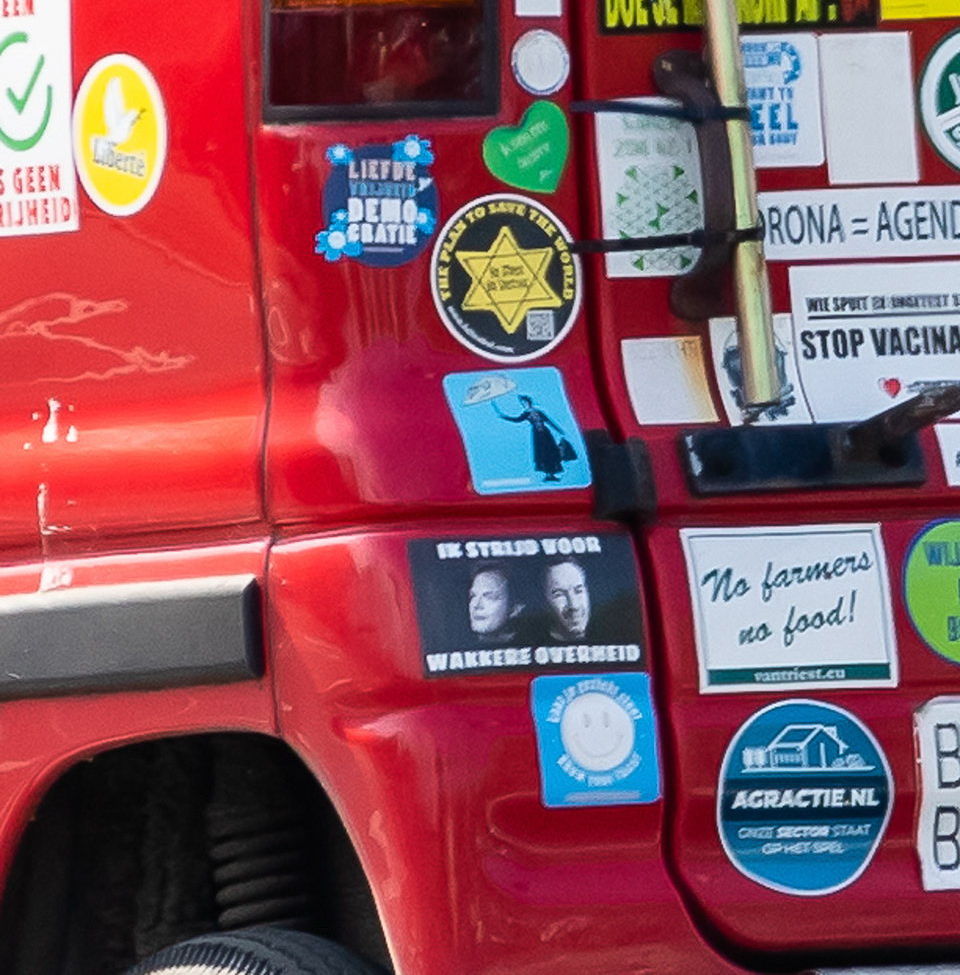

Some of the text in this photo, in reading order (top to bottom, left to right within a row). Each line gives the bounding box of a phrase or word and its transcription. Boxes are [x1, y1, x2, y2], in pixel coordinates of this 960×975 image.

[91, 134, 146, 178] Liberté
[13, 165, 61, 194] GEEN
[348, 159, 417, 181] LIEFDE
[347, 197, 418, 224] DEMO
[465, 206, 486, 223] TO
[488, 201, 526, 216] SAVE
[345, 223, 417, 245] CRATIE
[528, 208, 558, 237] THE
[440, 218, 467, 264] PLAN
[554, 236, 574, 300] WORLD
[438, 265, 451, 302] THE
[805, 296, 830, 313] WIE
[832, 295, 869, 312] SPUIT
[800, 328, 865, 361] STOP
[437, 536, 602, 560] IK STRIJD VOOR
[922, 541, 960, 568] WIJ
[700, 550, 874, 604] No farmers
[738, 589, 857, 648] no food!
[426, 644, 641, 673] WAKKERE OVERHEID
[753, 666, 847, 683] vantriest.eu
[731, 787, 881, 810] AGRACTIE.NL
[776, 825, 830, 839] SECTOR
